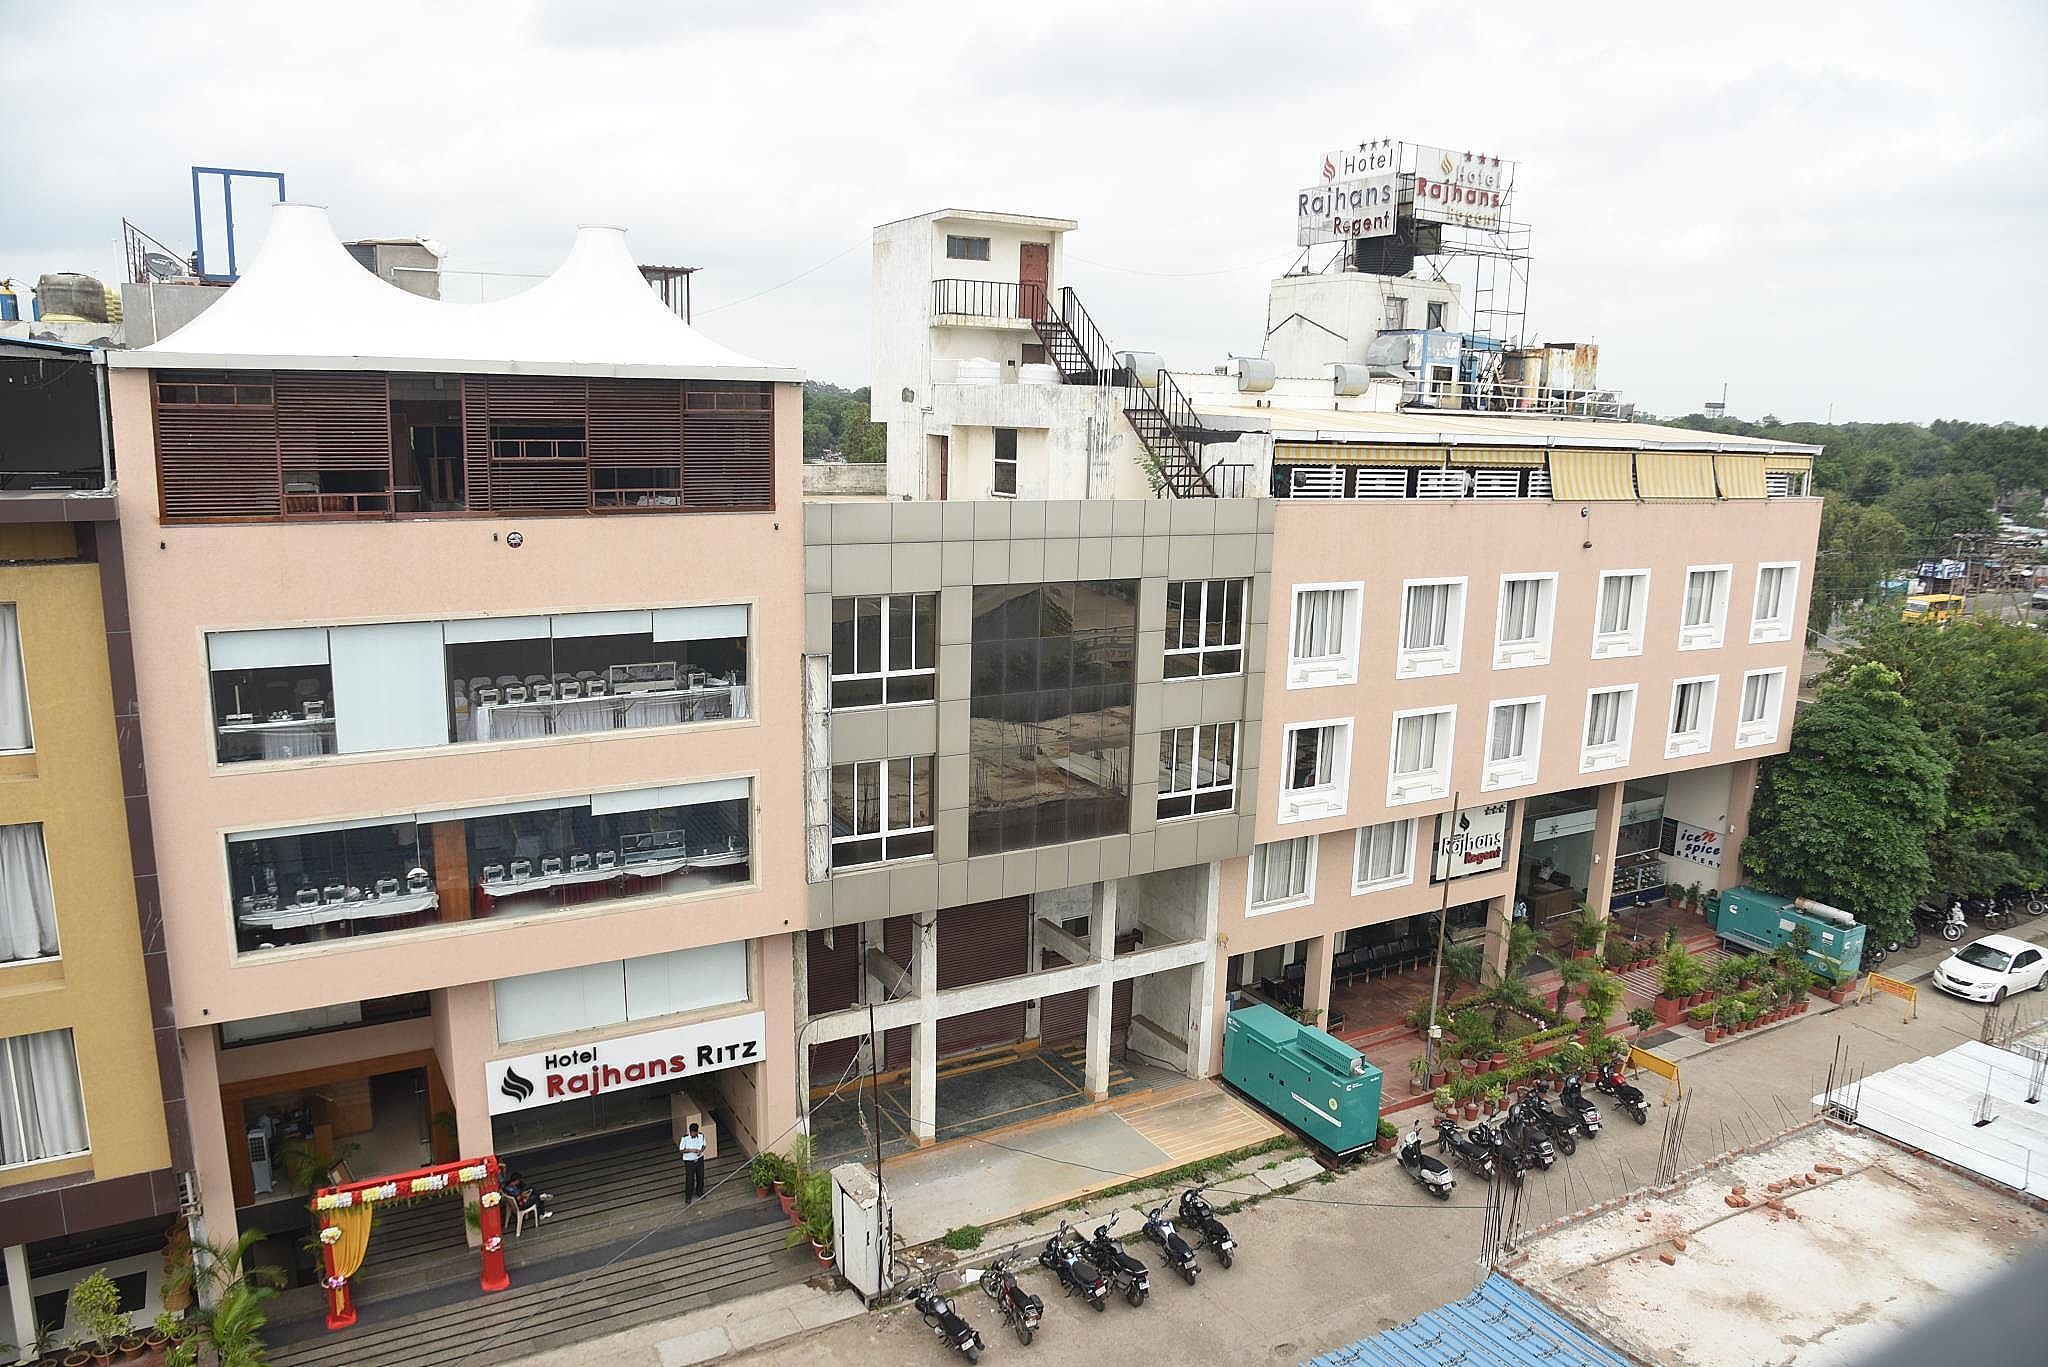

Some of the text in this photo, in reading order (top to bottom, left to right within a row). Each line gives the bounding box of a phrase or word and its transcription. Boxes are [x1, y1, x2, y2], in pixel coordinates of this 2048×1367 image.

[1344, 148, 1393, 175] Hotel
[1299, 184, 1391, 218] Rajhans
[1416, 177, 1499, 208] Rajhans
[1333, 210, 1390, 237] Regent
[1681, 829, 1701, 842] ice
[1685, 842, 1720, 855] spice
[545, 1046, 598, 1070] Hotel
[546, 1054, 687, 1097] Rajhans
